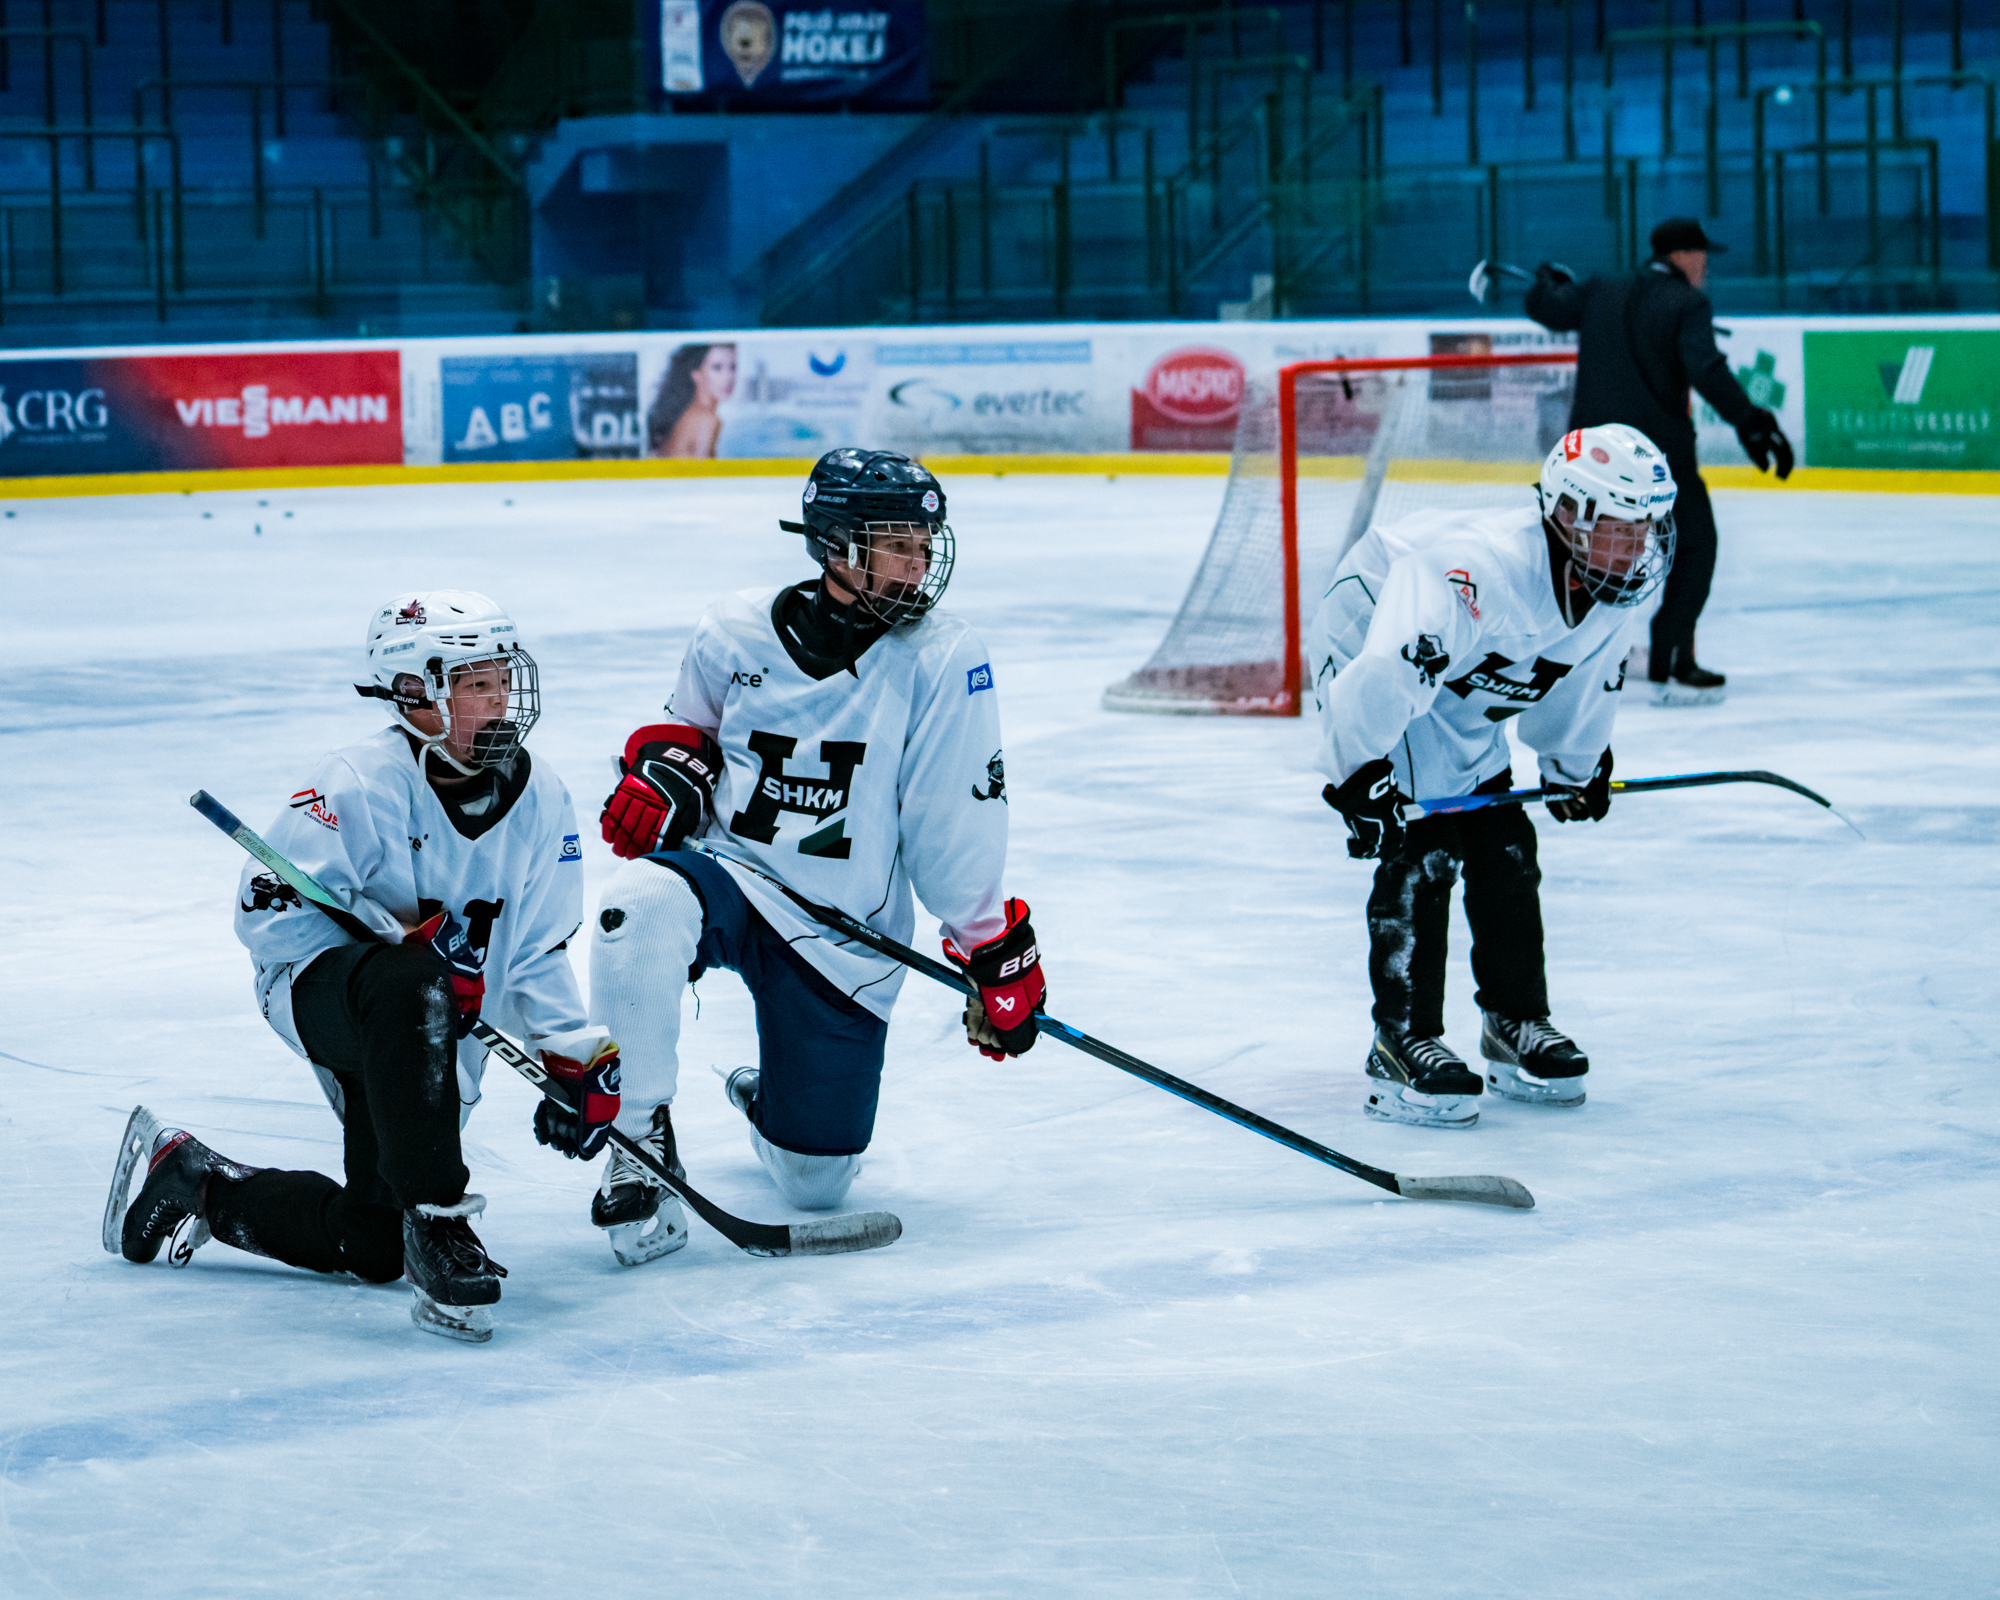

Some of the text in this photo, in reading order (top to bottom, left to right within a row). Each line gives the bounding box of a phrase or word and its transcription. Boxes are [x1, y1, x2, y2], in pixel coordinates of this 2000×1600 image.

[782, 33, 886, 62] HOKEJ
[16, 389, 109, 431] CRG
[1465, 673, 1542, 700] SHKM
[761, 776, 844, 809] SHKM
[310, 803, 338, 826] PLUS
